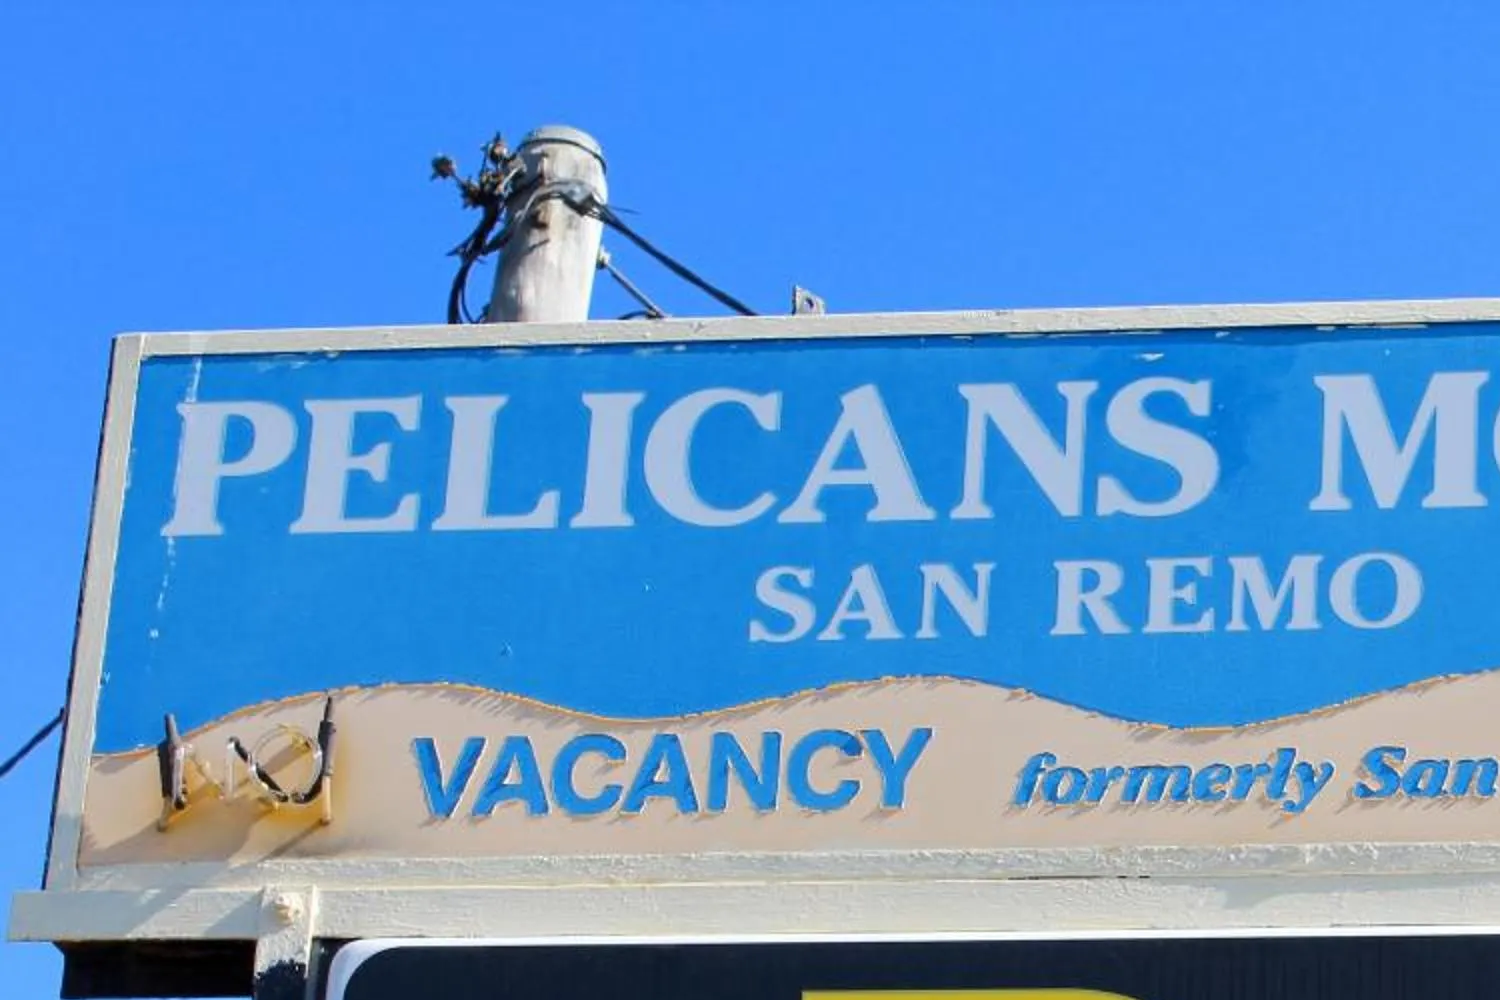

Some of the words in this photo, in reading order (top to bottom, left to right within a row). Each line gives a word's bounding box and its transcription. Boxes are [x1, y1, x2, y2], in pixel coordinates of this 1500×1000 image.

[162, 376, 1220, 535] PELICANS
[749, 564, 994, 642] SAN
[1054, 553, 1423, 636] REMO
[414, 727, 932, 816] VACANCY
[1018, 747, 1336, 809] formerly
[1355, 745, 1500, 797] San
